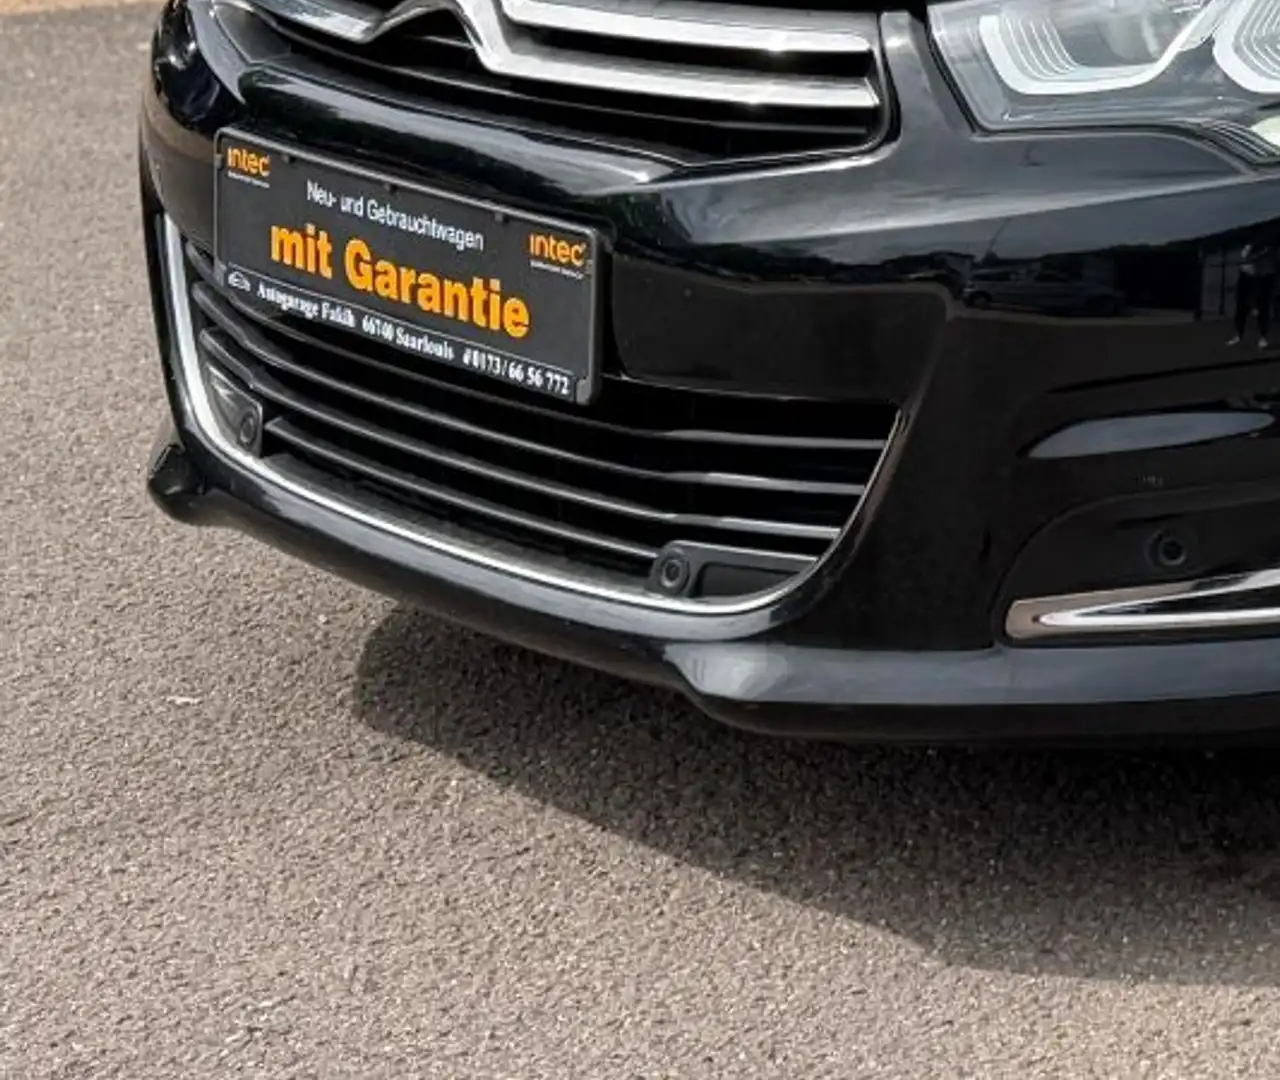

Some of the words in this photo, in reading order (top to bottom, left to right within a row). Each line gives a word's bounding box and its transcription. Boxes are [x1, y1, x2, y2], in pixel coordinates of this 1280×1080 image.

[307, 179, 337, 208] Neu-
[340, 196, 364, 218] und
[367, 199, 484, 251] Gebrauchtwagen
[271, 223, 332, 279] mit
[345, 238, 529, 338] Garantie
[545, 371, 568, 395] 772
